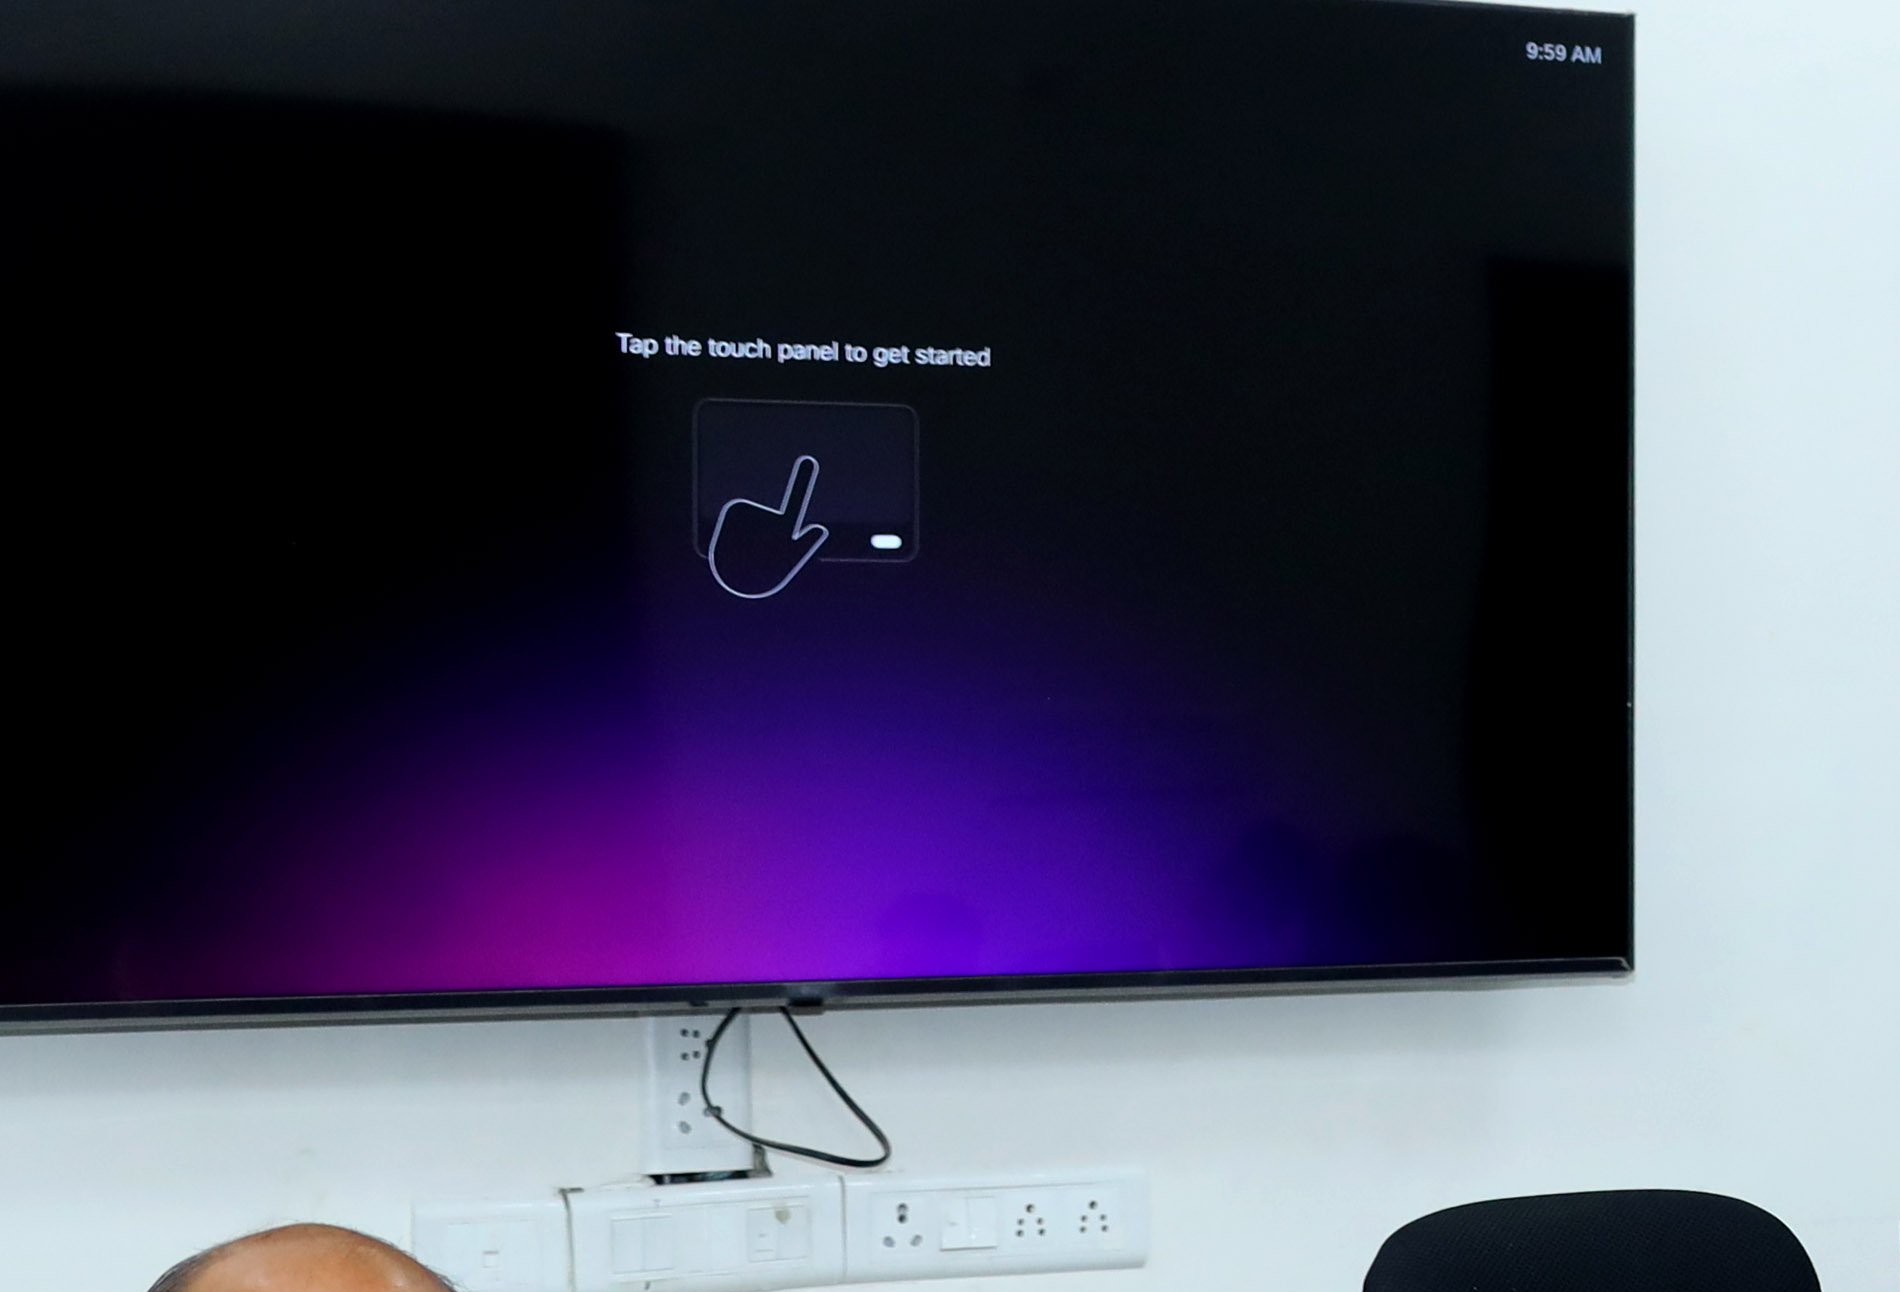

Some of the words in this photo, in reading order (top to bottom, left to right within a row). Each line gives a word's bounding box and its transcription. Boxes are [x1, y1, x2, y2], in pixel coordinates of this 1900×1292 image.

[1525, 41, 1567, 62] 9:59
[1571, 45, 1602, 64] AM
[615, 332, 659, 359] Tap
[664, 334, 701, 357] the
[708, 338, 771, 360] touch
[778, 341, 839, 364] panel
[845, 343, 868, 363] to
[873, 344, 910, 368] get
[915, 345, 991, 367] started
